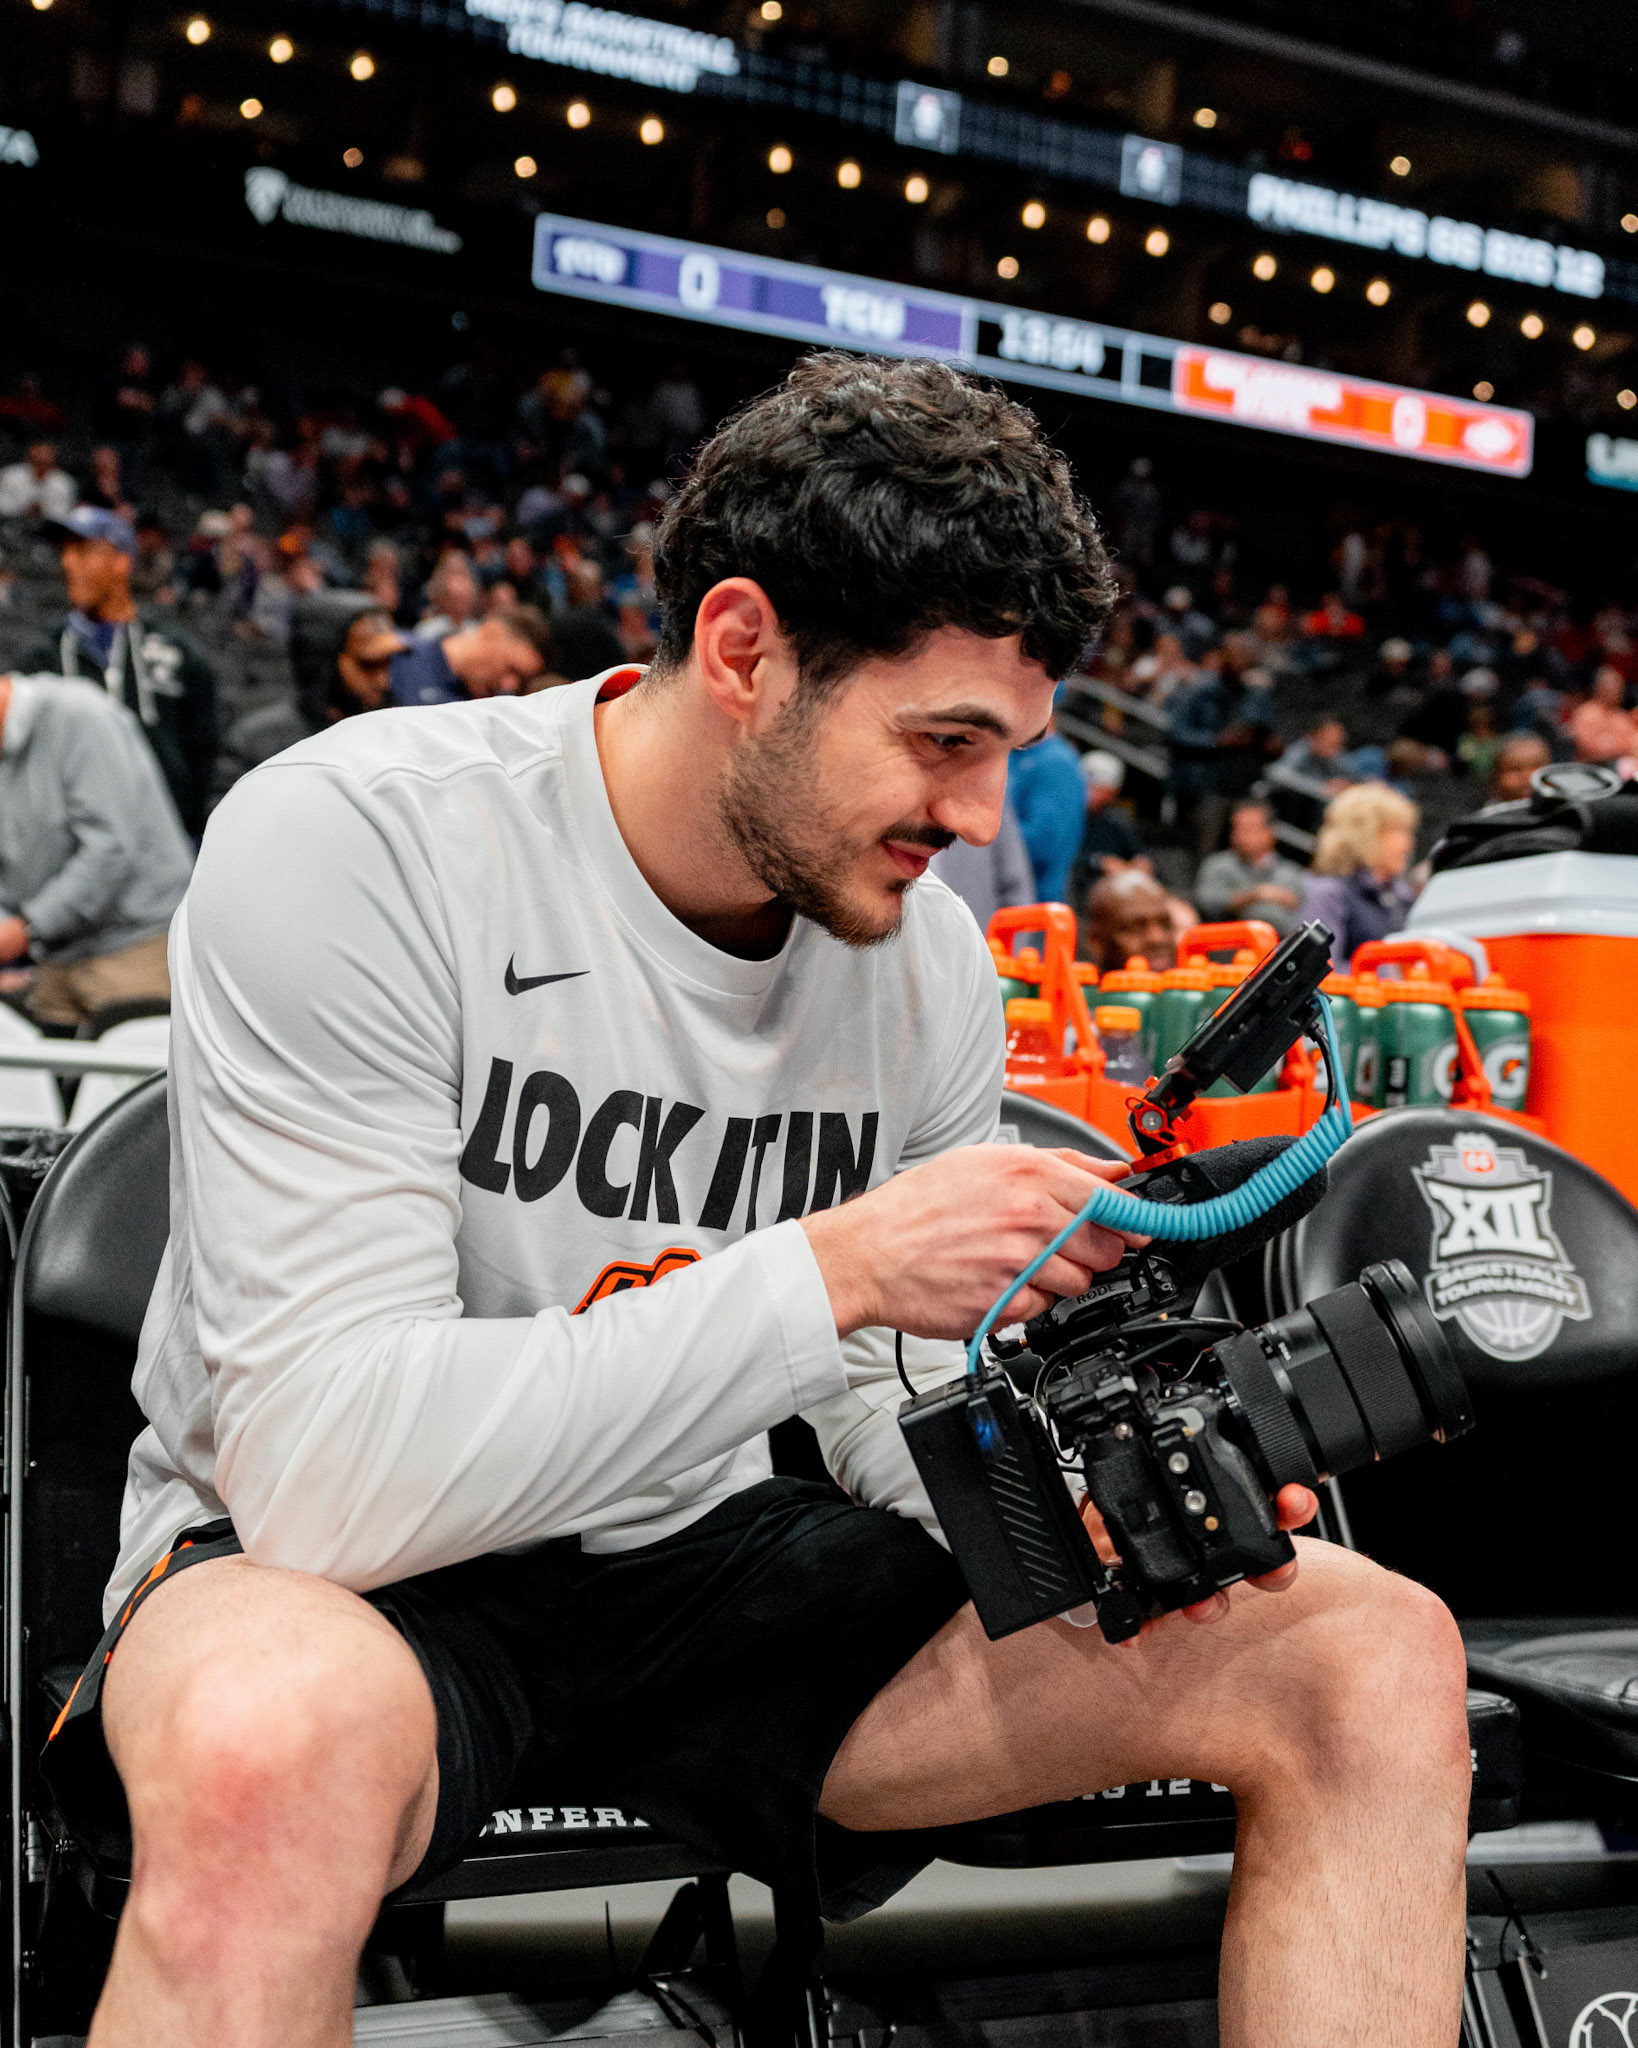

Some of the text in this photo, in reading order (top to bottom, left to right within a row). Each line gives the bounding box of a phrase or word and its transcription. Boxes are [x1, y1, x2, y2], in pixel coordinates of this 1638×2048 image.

[1247, 172, 1429, 258] PHILLIPS
[1482, 228, 1556, 287] BIG
[678, 252, 720, 311] 0
[821, 285, 906, 341] TCU
[1484, 1043, 1528, 1100] G
[459, 1056, 880, 1235] LOCK IT IN
[1427, 1180, 1557, 1258] XII
[1436, 1277, 1577, 1306] TOURNAMENT
[1437, 1261, 1572, 1290] BASKETBALL
